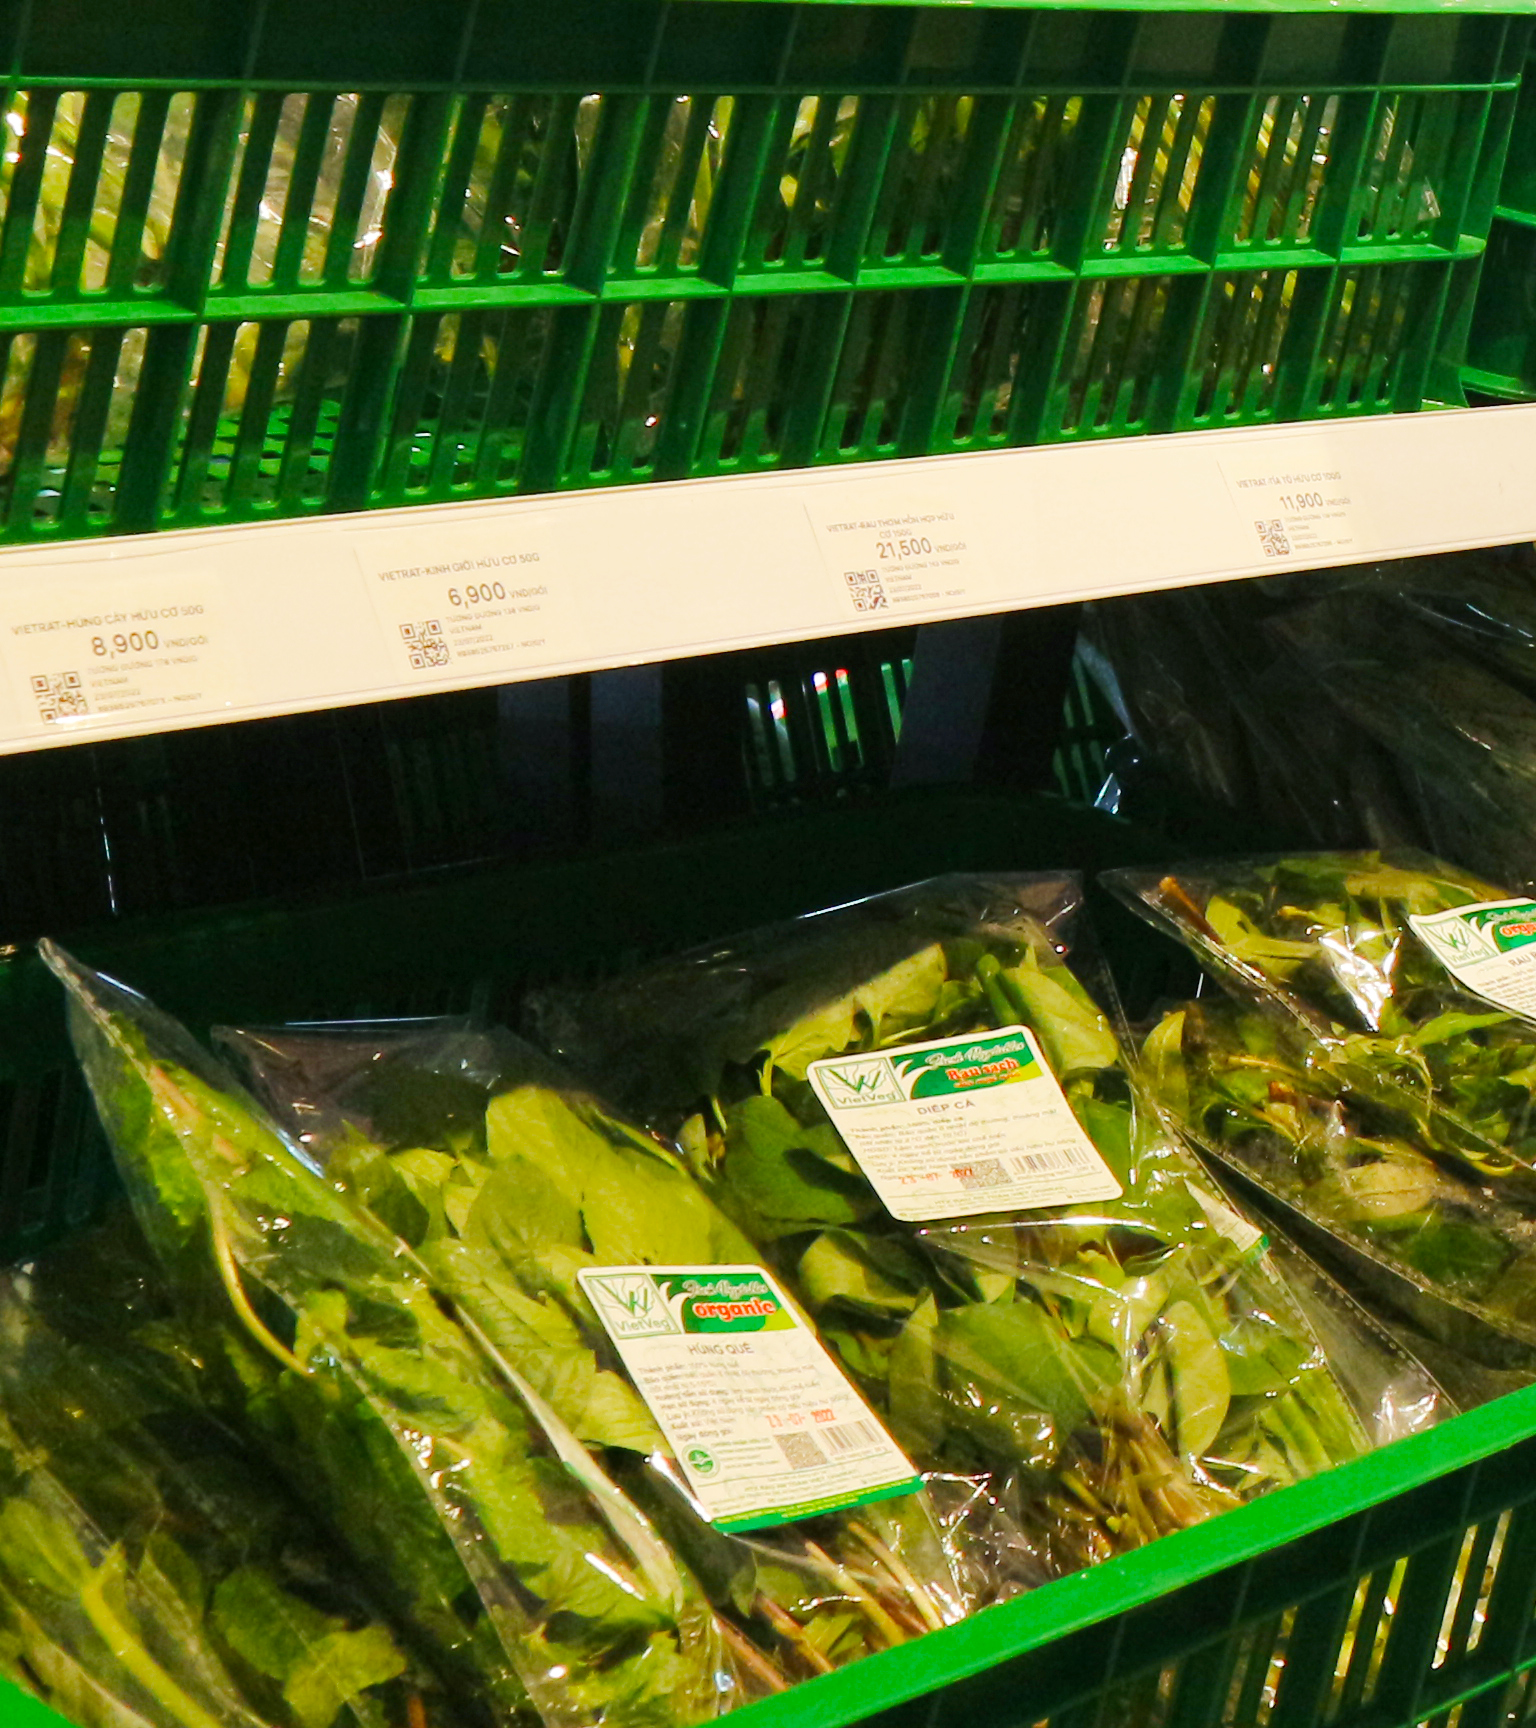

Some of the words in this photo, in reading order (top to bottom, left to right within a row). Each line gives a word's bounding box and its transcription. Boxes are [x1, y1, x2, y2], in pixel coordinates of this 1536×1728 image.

[1279, 492, 1323, 512] 11,900
[876, 537, 932, 560] 21,500
[447, 581, 506, 609] 6,900
[91, 630, 159, 659] 8,900
[1508, 954, 1530, 967] RAU
[946, 1064, 981, 1080] Rau
[837, 1092, 896, 1105] VietVeg
[693, 1298, 776, 1322] organic
[614, 1318, 671, 1333] VietVeg
[688, 1342, 723, 1355] HÚNG
